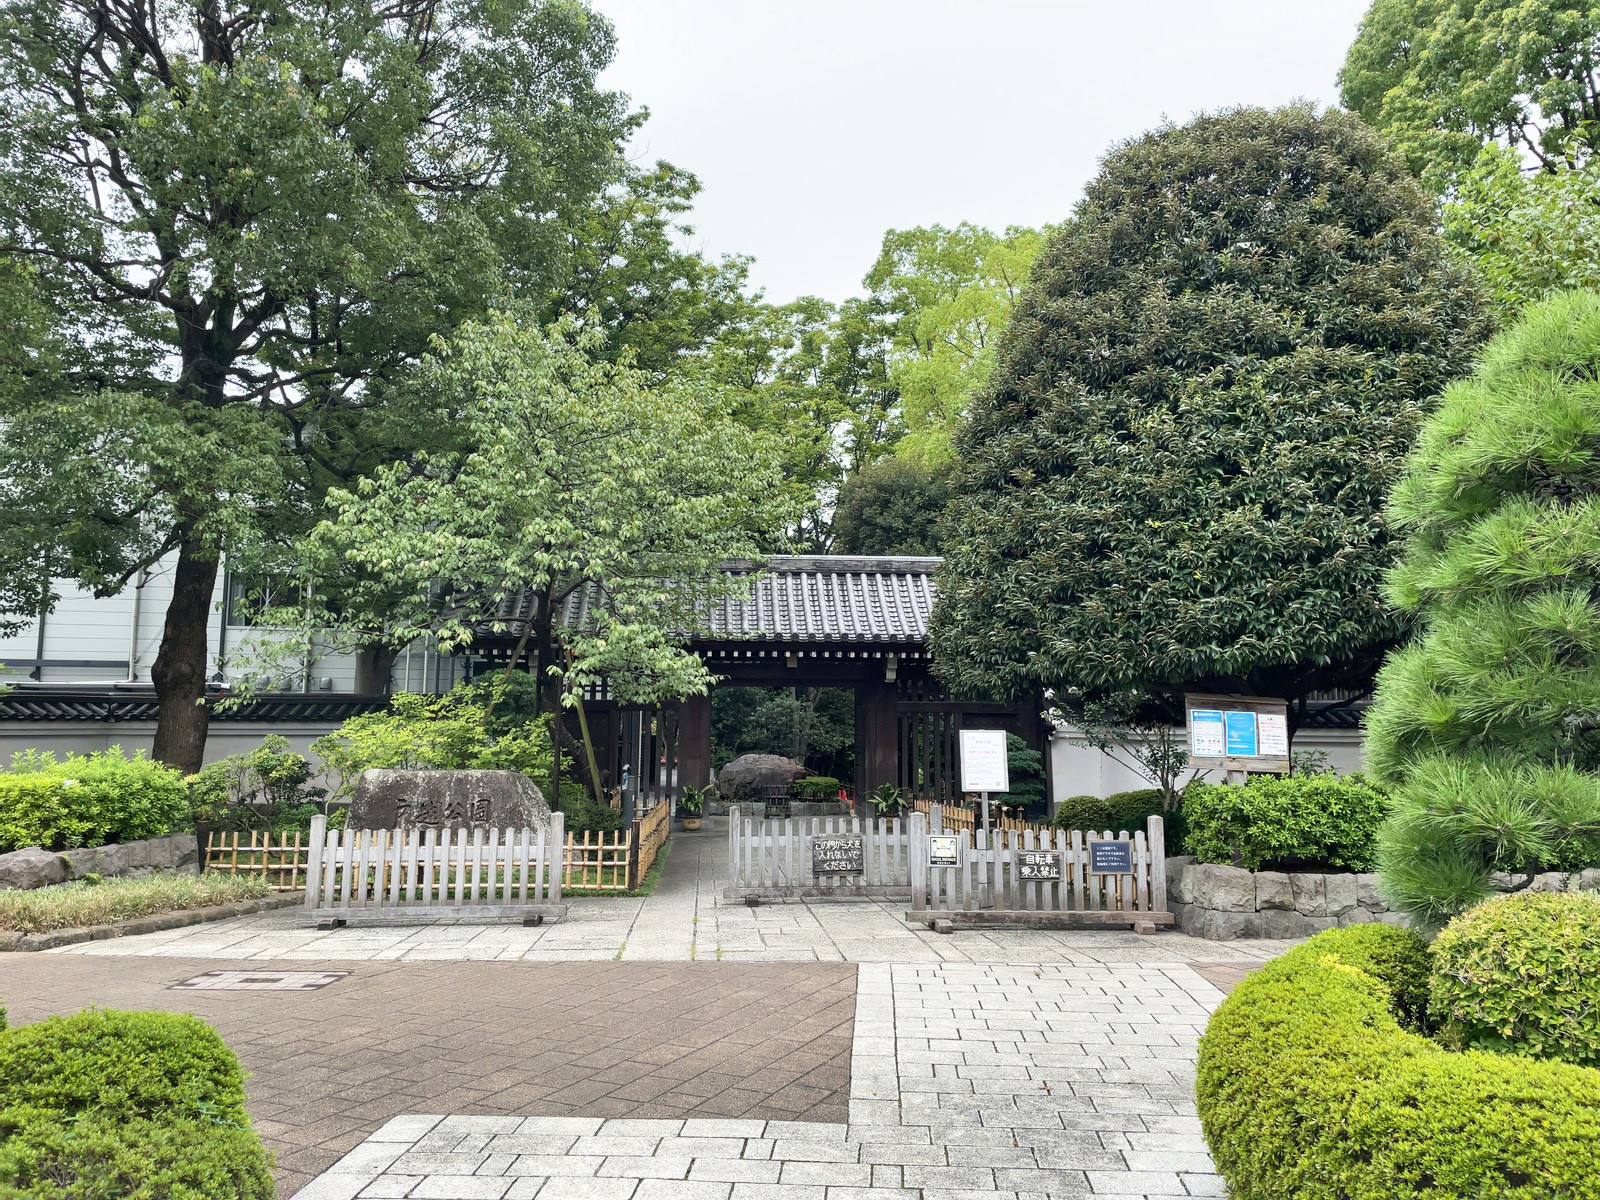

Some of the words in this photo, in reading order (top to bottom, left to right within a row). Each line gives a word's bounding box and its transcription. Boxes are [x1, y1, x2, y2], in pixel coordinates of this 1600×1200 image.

[815, 840, 861, 850] この門から犬を
[818, 850, 860, 860] 入れないで
[1026, 853, 1054, 865] 自転車
[823, 860, 856, 870] ください
[1020, 865, 1060, 877] 乗入禁止
